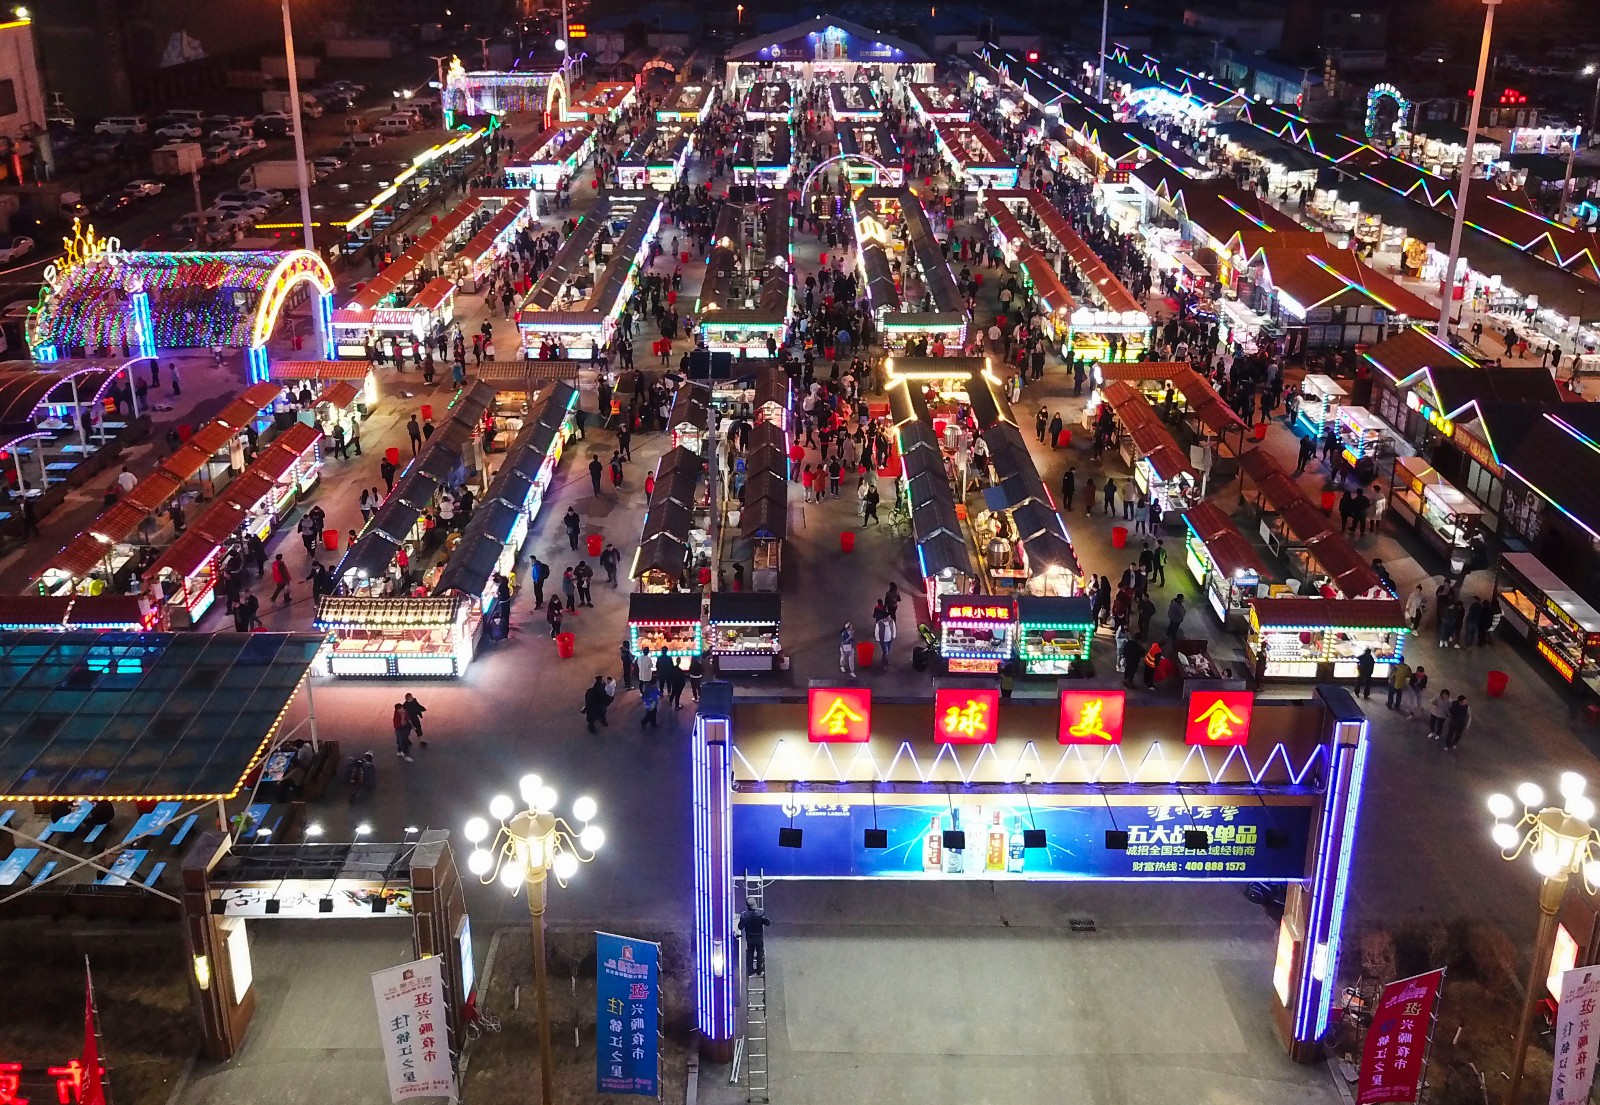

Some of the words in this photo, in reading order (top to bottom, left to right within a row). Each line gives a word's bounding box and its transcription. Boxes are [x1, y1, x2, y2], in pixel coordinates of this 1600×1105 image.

[819, 697, 1244, 741] 全球美食
[1184, 861, 1203, 871] 400
[1225, 861, 1246, 871] 1573
